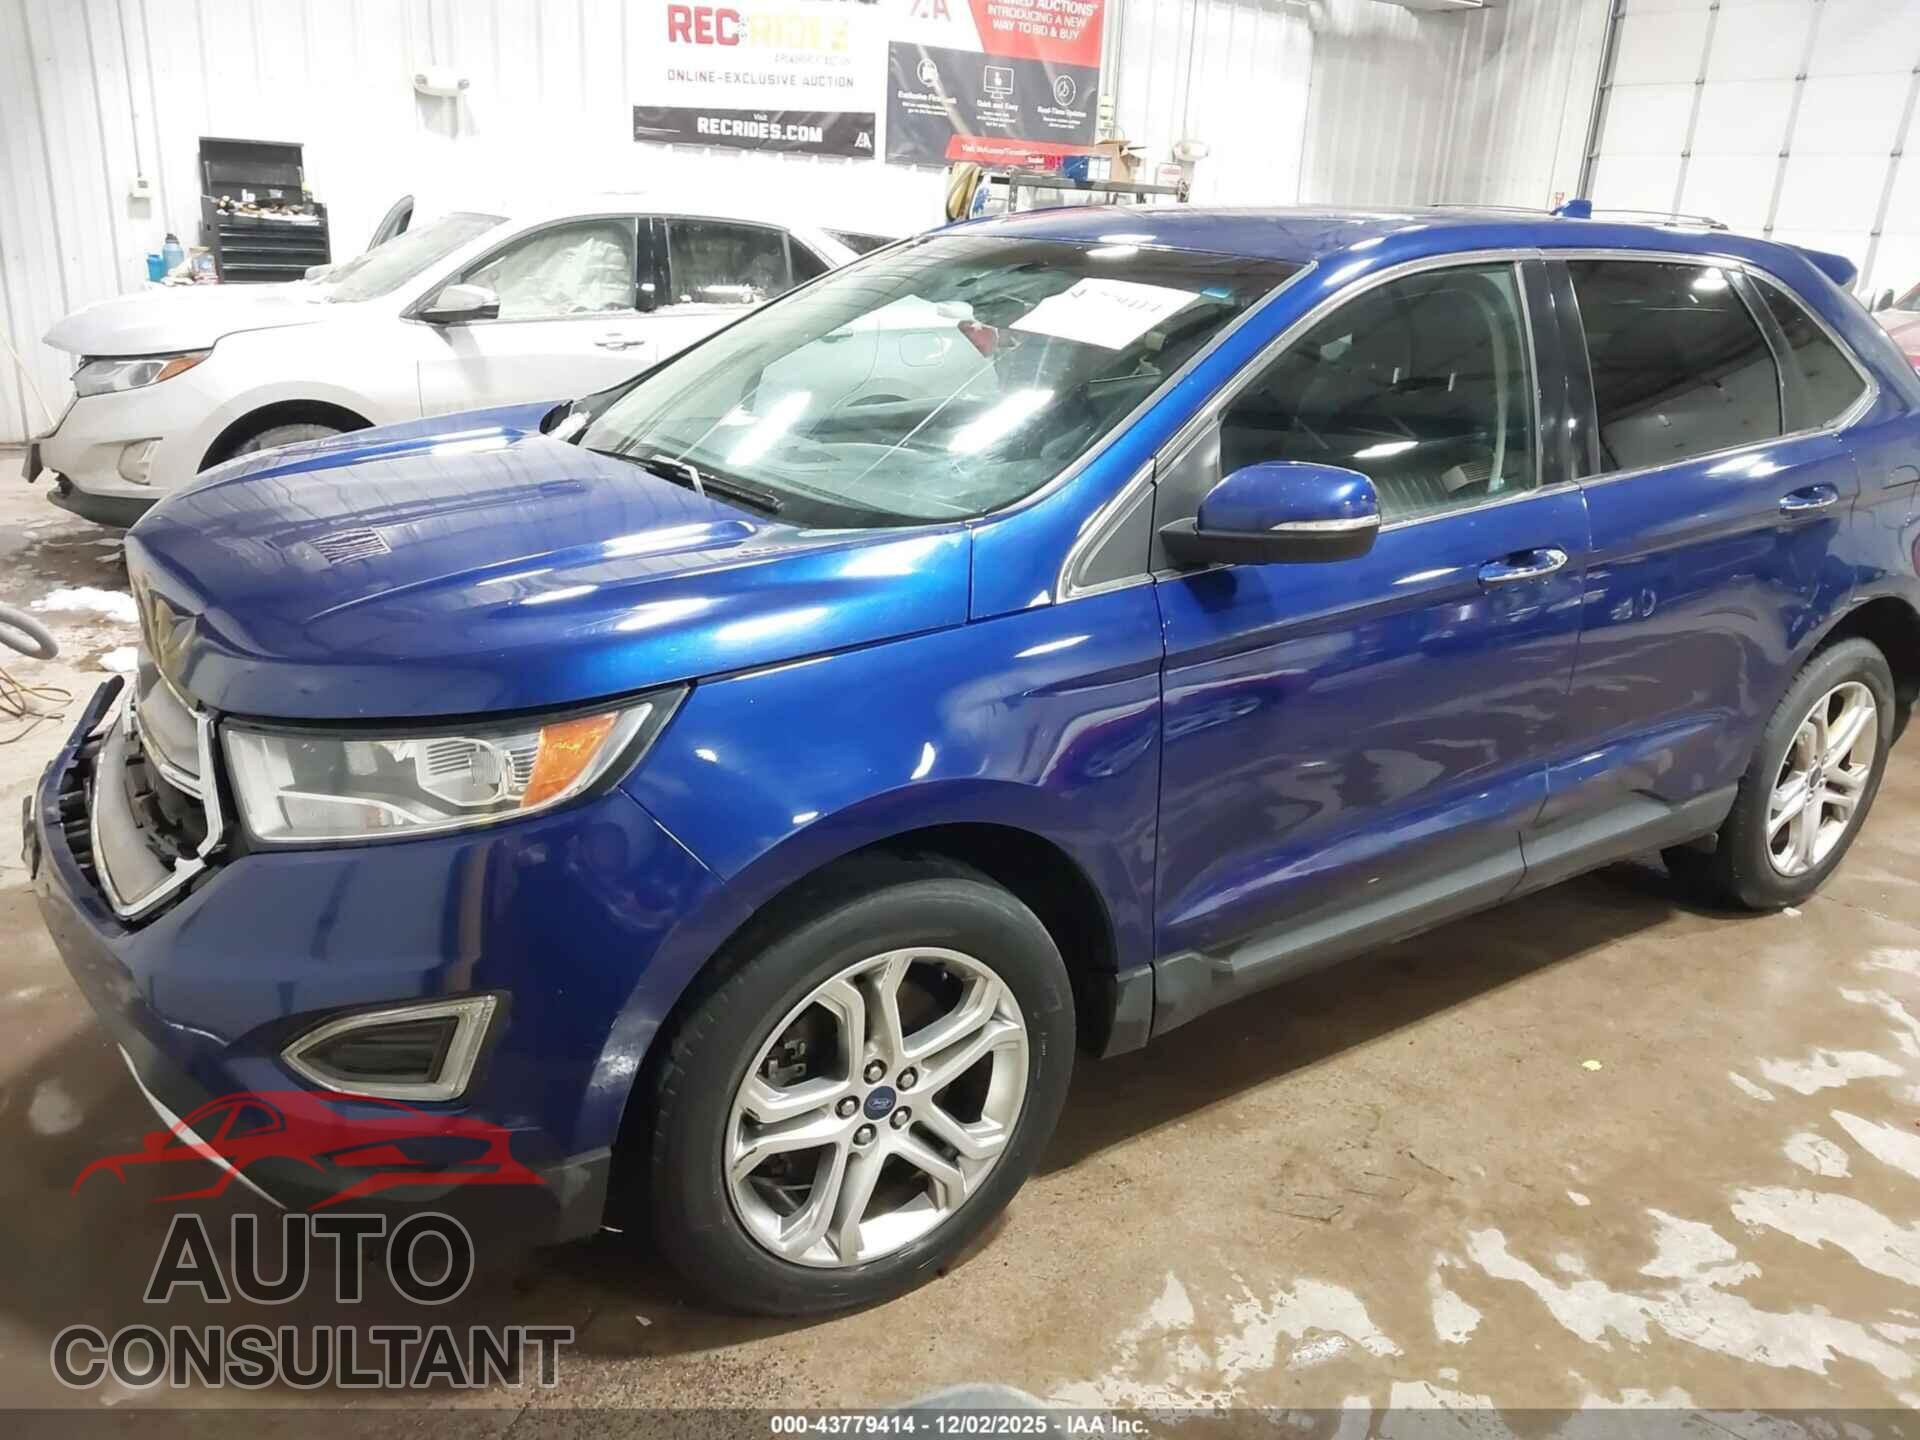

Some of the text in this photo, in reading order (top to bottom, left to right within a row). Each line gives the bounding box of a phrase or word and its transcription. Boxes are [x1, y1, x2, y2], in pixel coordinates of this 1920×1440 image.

[987, 4, 1088, 28] INTRODUCING A NEW
[992, 19, 1015, 31] WAY
[1017, 21, 1031, 33] TO
[1032, 24, 1048, 36] BID
[1059, 28, 1080, 40] BUY
[667, 69, 854, 88] ONLINE-EXCLUSIVE AUCTION
[697, 117, 823, 143] RECRIDES.COM
